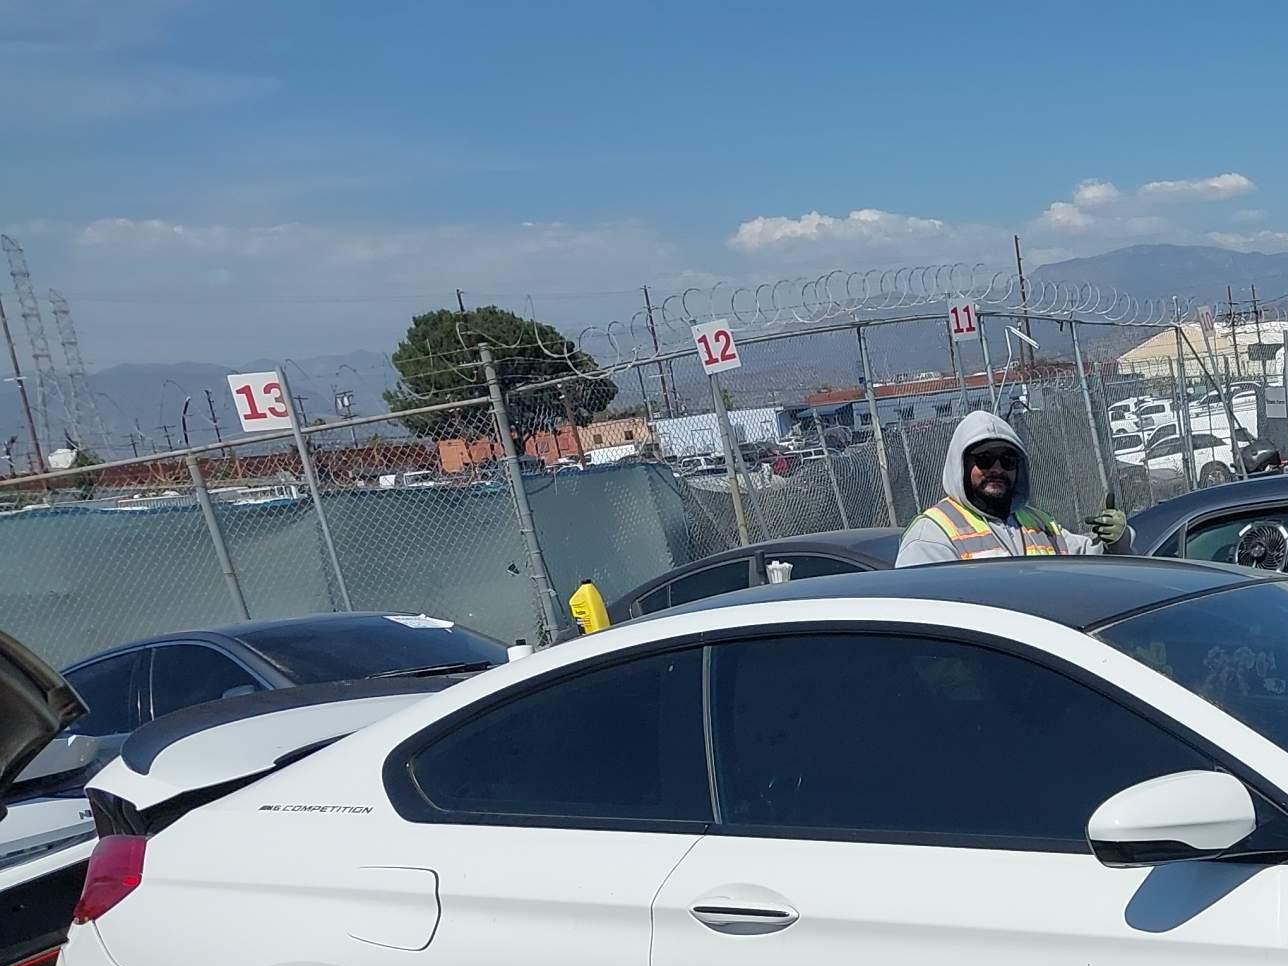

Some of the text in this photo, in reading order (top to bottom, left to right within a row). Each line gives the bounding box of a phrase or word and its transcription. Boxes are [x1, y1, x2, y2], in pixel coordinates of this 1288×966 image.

[950, 305, 976, 334] 11
[697, 329, 737, 366] 12
[235, 382, 289, 420] 13
[282, 805, 374, 814] COMPETITION
